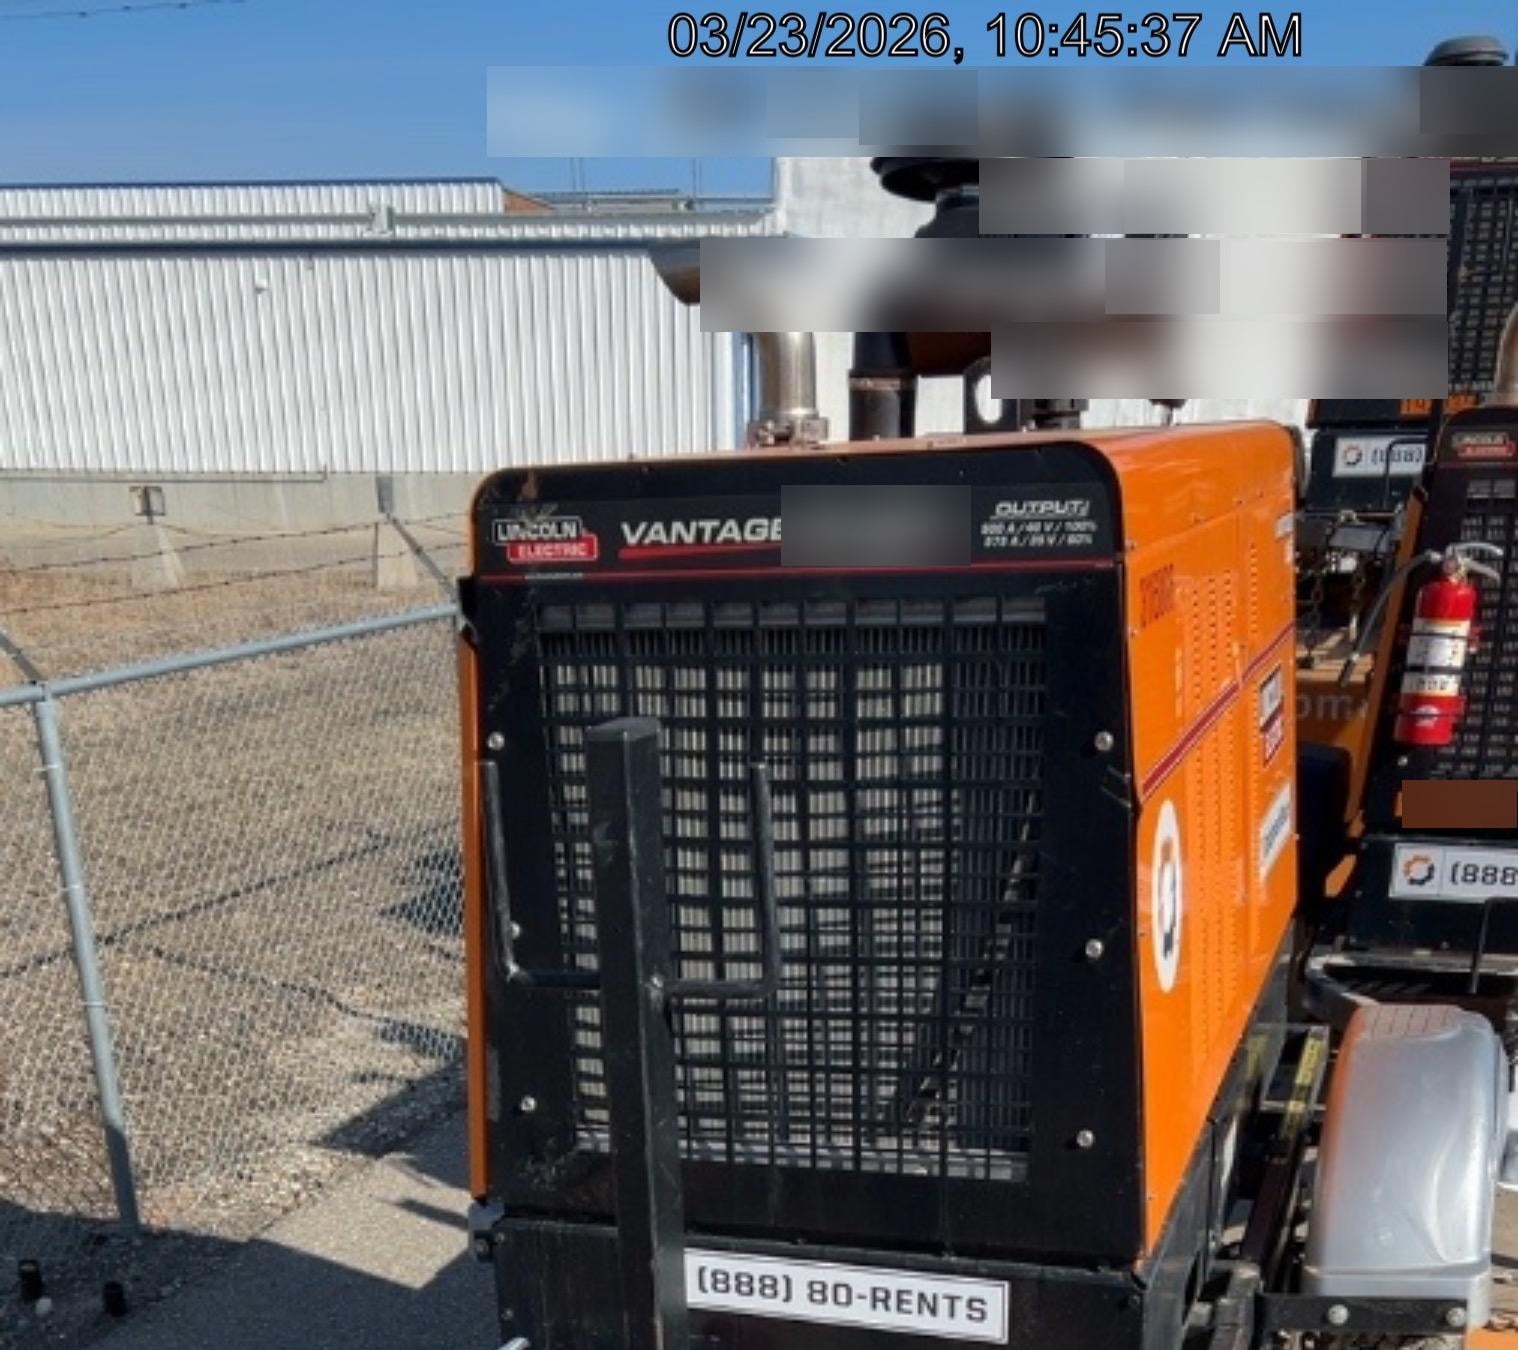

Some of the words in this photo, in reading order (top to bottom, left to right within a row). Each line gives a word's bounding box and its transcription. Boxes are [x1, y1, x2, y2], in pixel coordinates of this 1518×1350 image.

[496, 520, 578, 541] LINCOLN
[620, 517, 782, 546] VANTAGE
[698, 1264, 793, 1303] (888)
[806, 1279, 988, 1324] 80-RENTS
